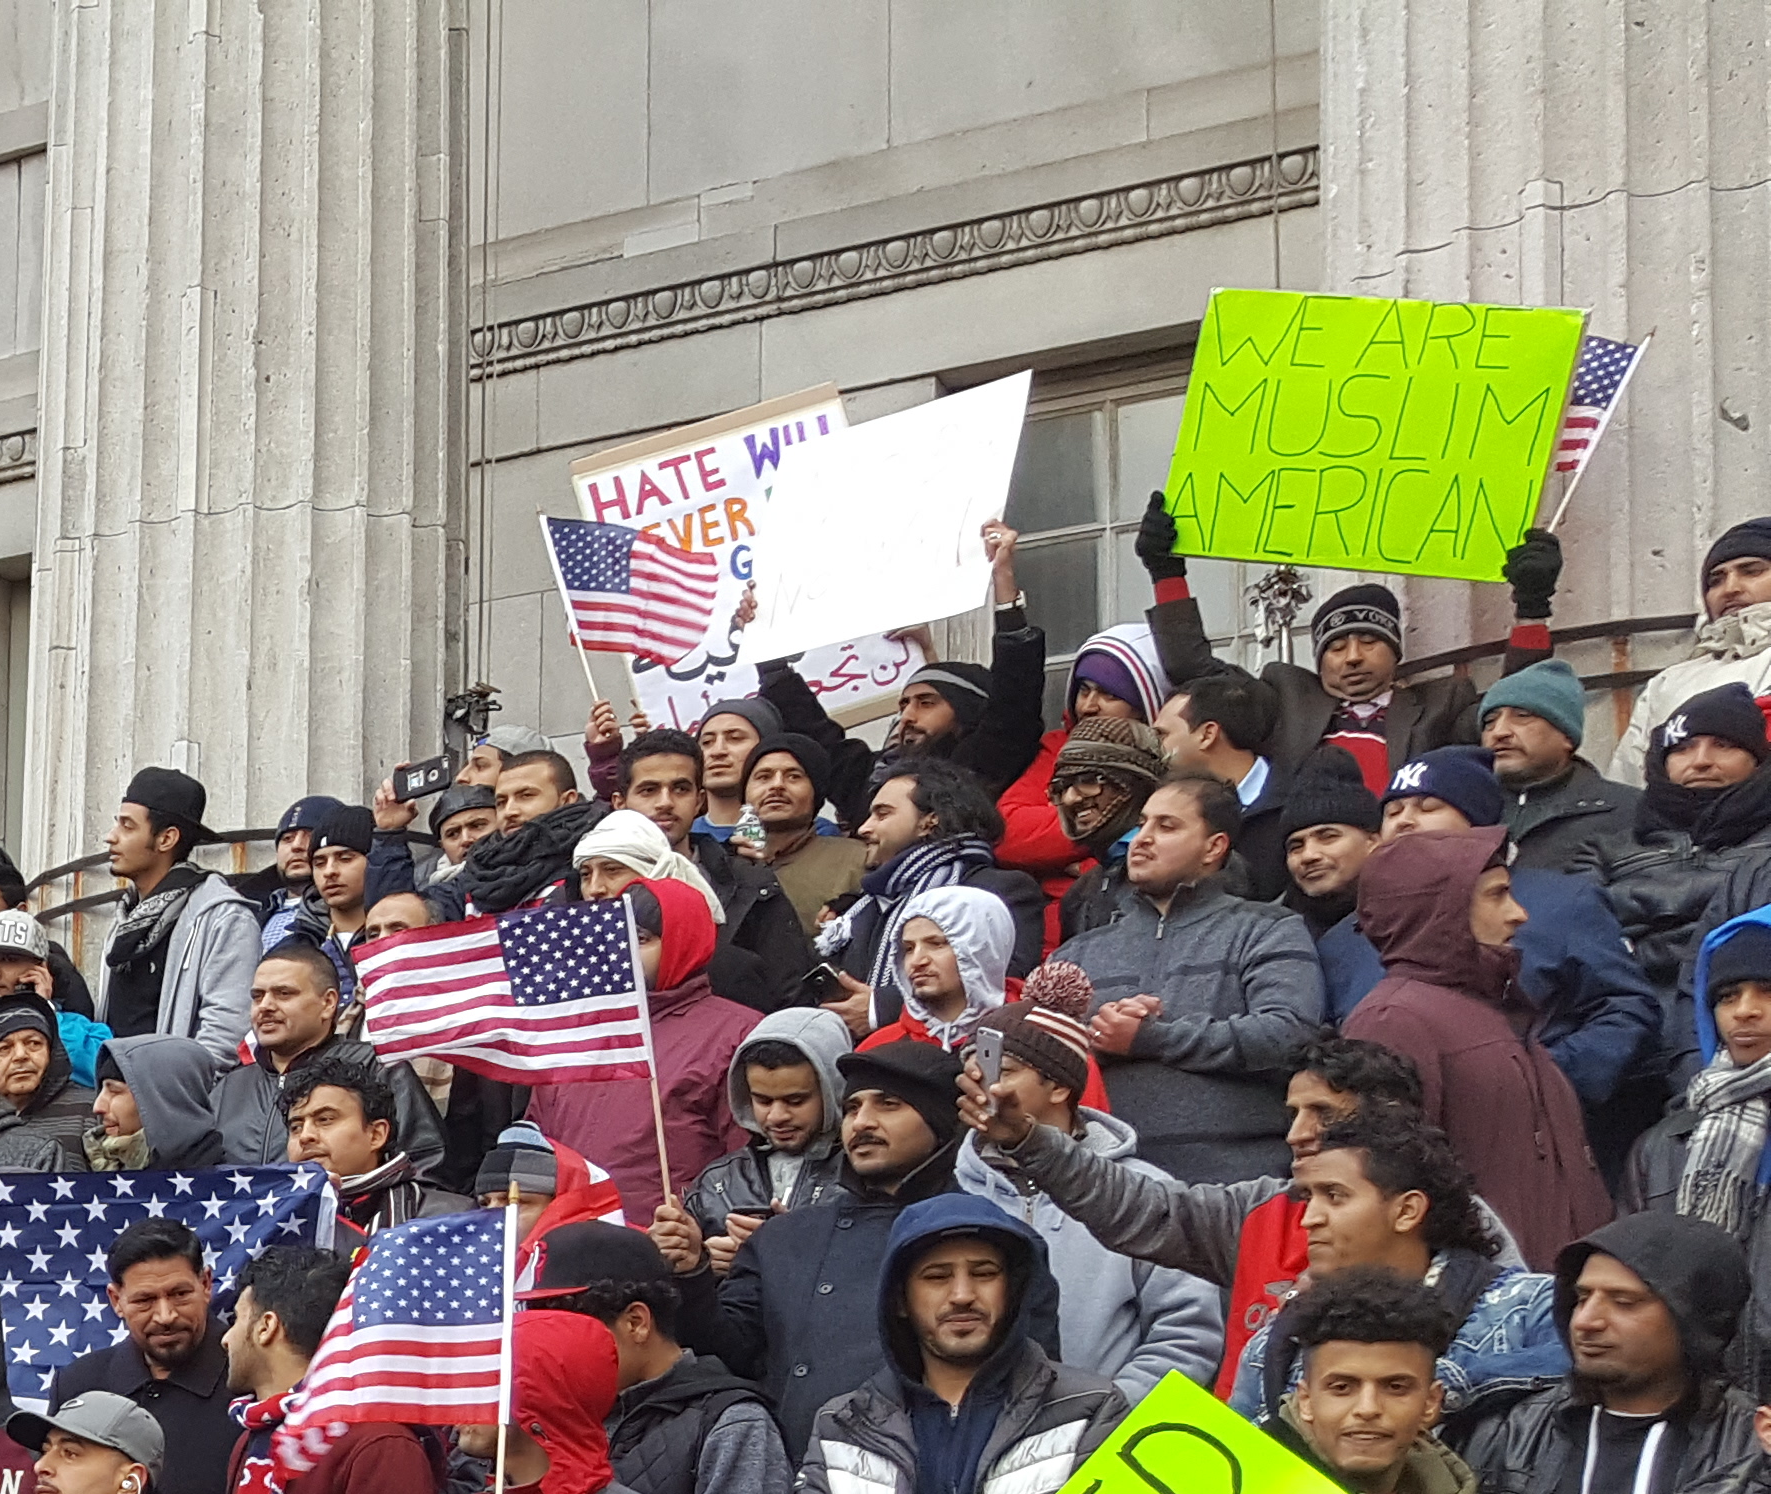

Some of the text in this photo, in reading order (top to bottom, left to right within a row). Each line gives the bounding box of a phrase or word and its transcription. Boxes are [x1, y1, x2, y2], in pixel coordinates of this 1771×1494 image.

[1213, 294, 1534, 370] WE ARE
[1193, 374, 1551, 467] MUSLIM
[587, 446, 727, 524] HATE
[1169, 465, 1534, 564] AMERICAN
